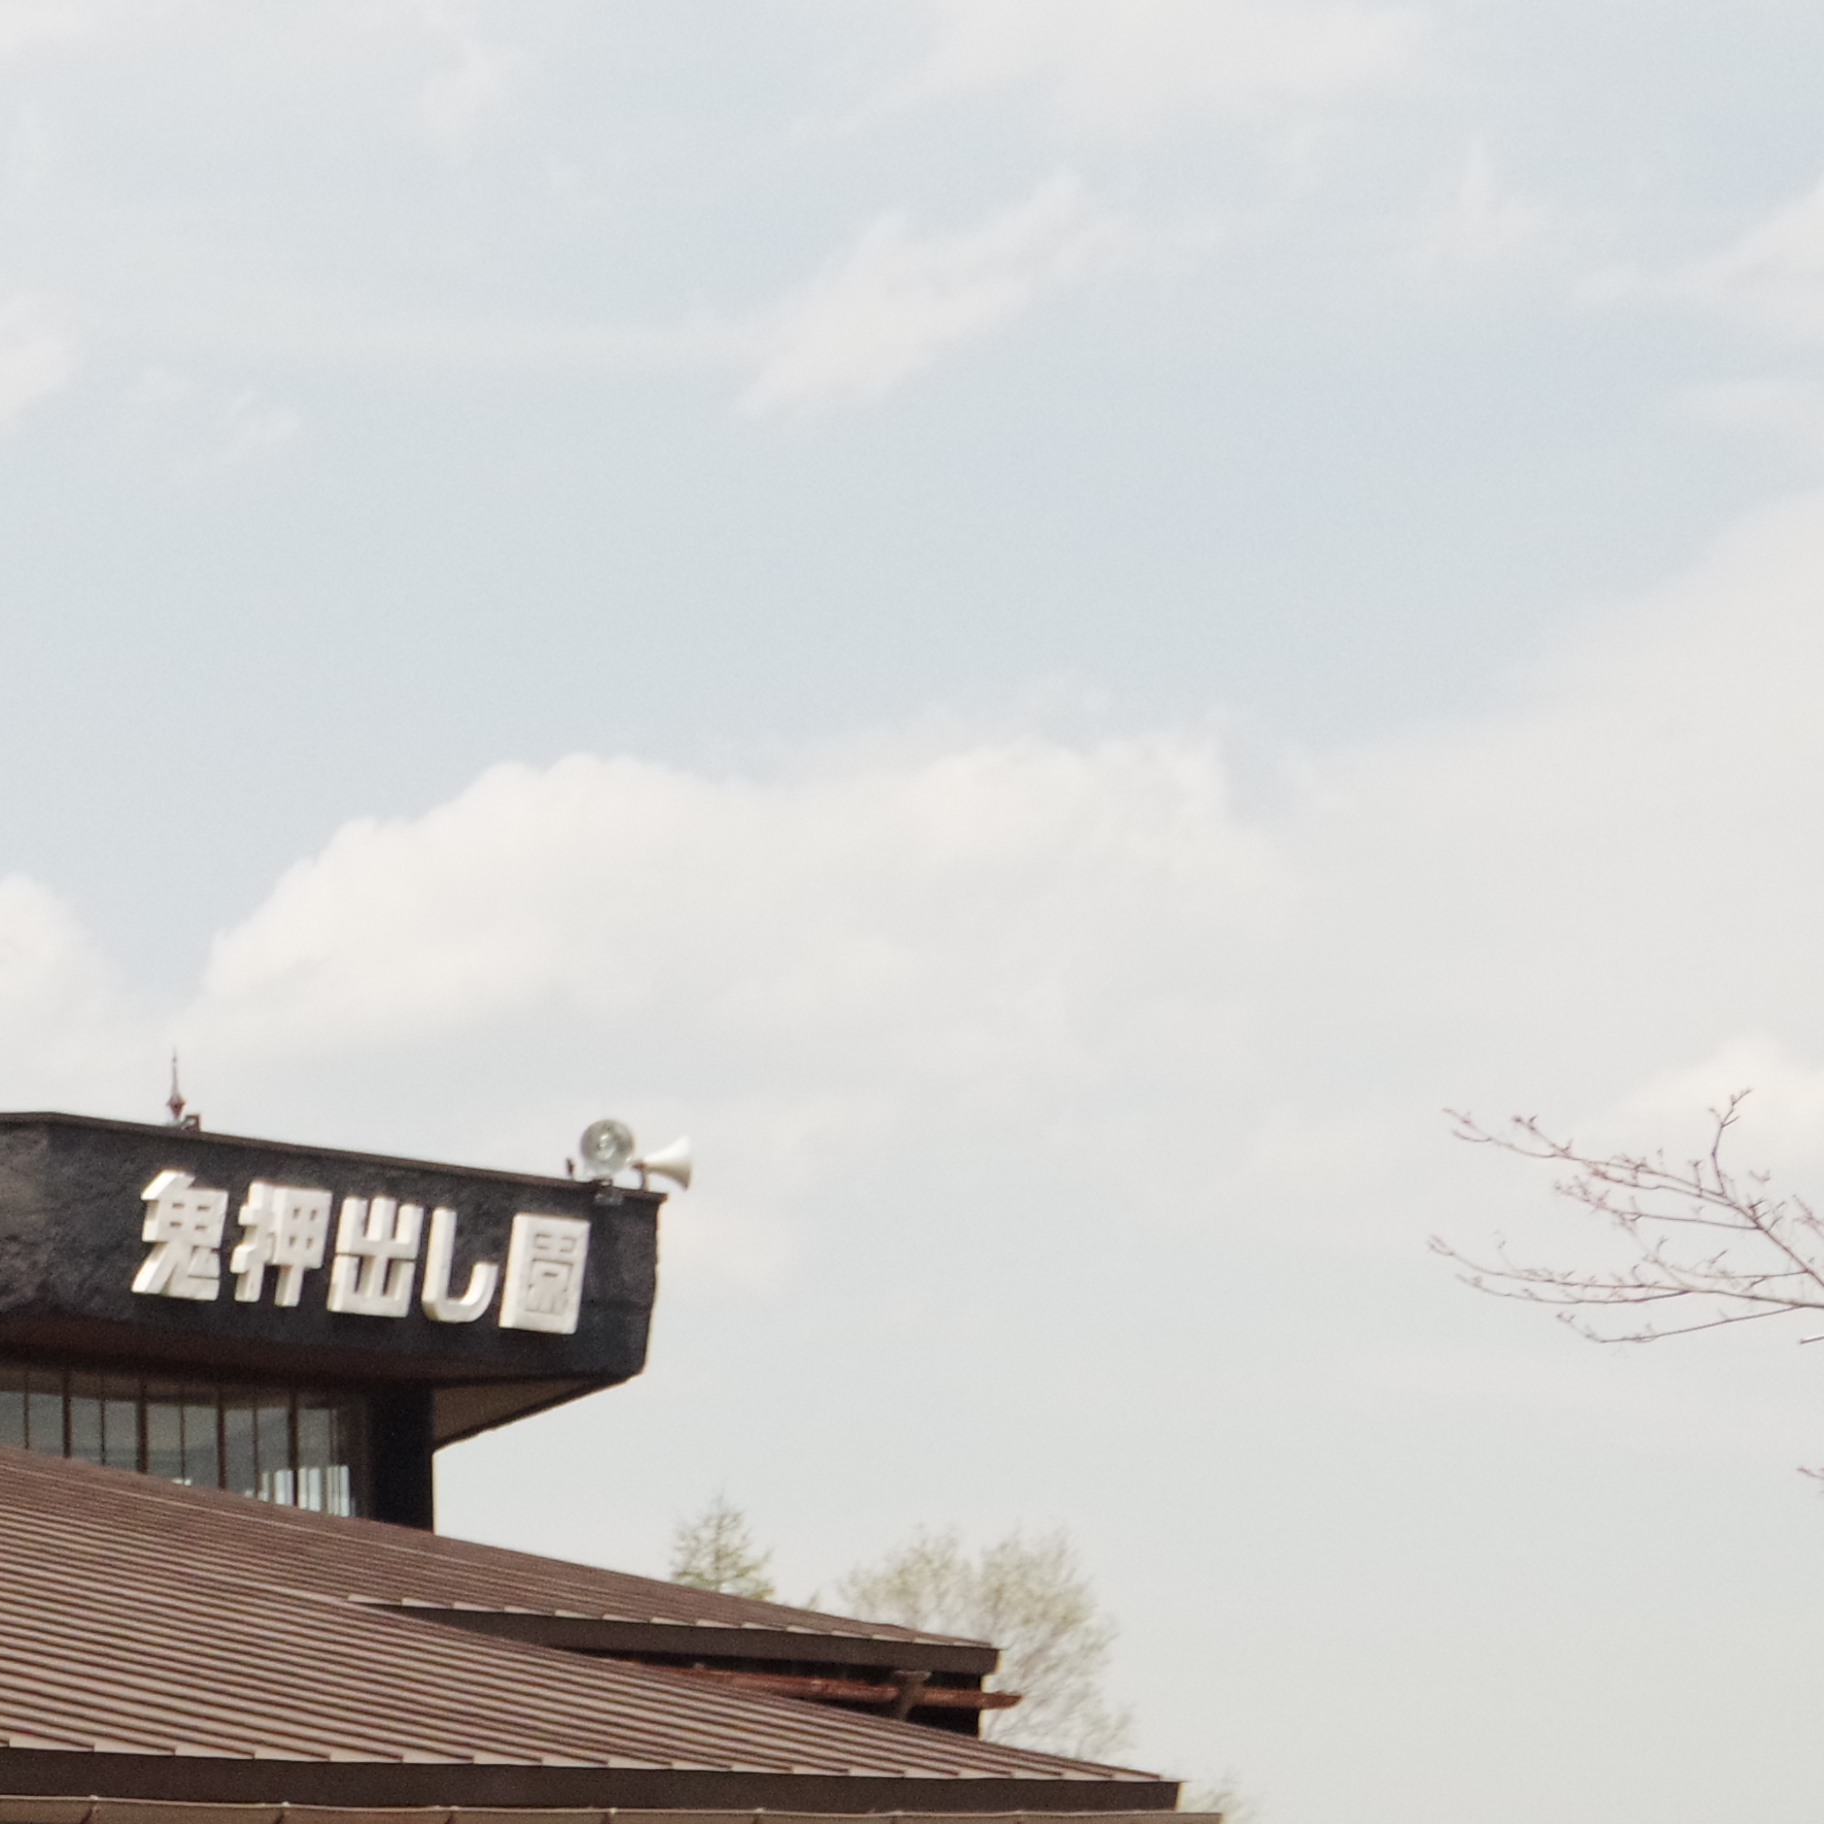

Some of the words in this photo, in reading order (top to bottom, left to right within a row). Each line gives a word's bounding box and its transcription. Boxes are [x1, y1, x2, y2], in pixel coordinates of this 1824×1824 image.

[131, 1169, 591, 1334] 鬼押出し園
